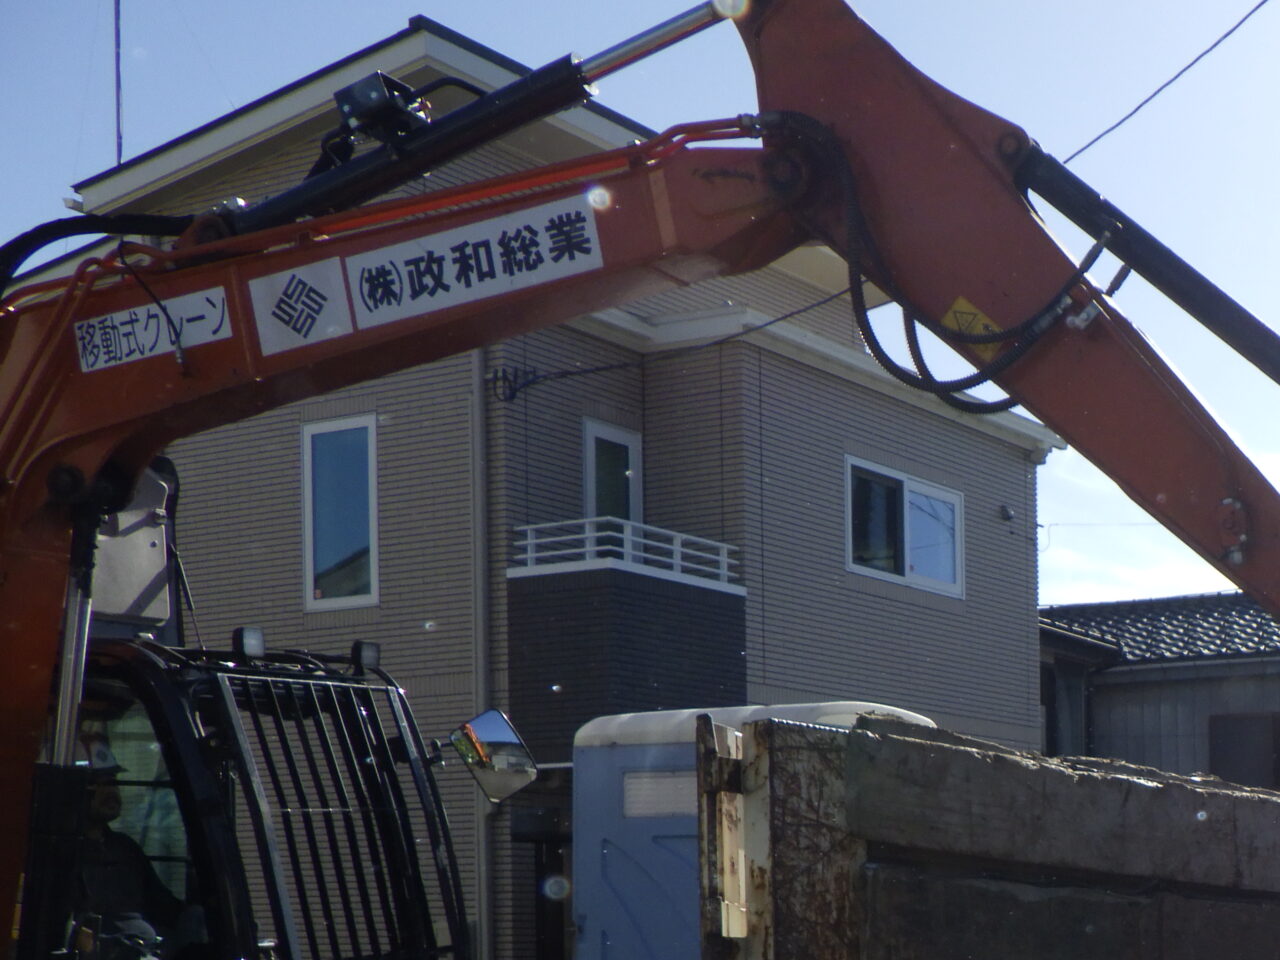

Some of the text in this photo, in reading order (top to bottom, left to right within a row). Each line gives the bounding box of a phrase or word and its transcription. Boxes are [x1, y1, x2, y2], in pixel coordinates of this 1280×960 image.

[360, 210, 593, 313] (株)政和総業
[76, 296, 226, 369] 移動式クレーン
